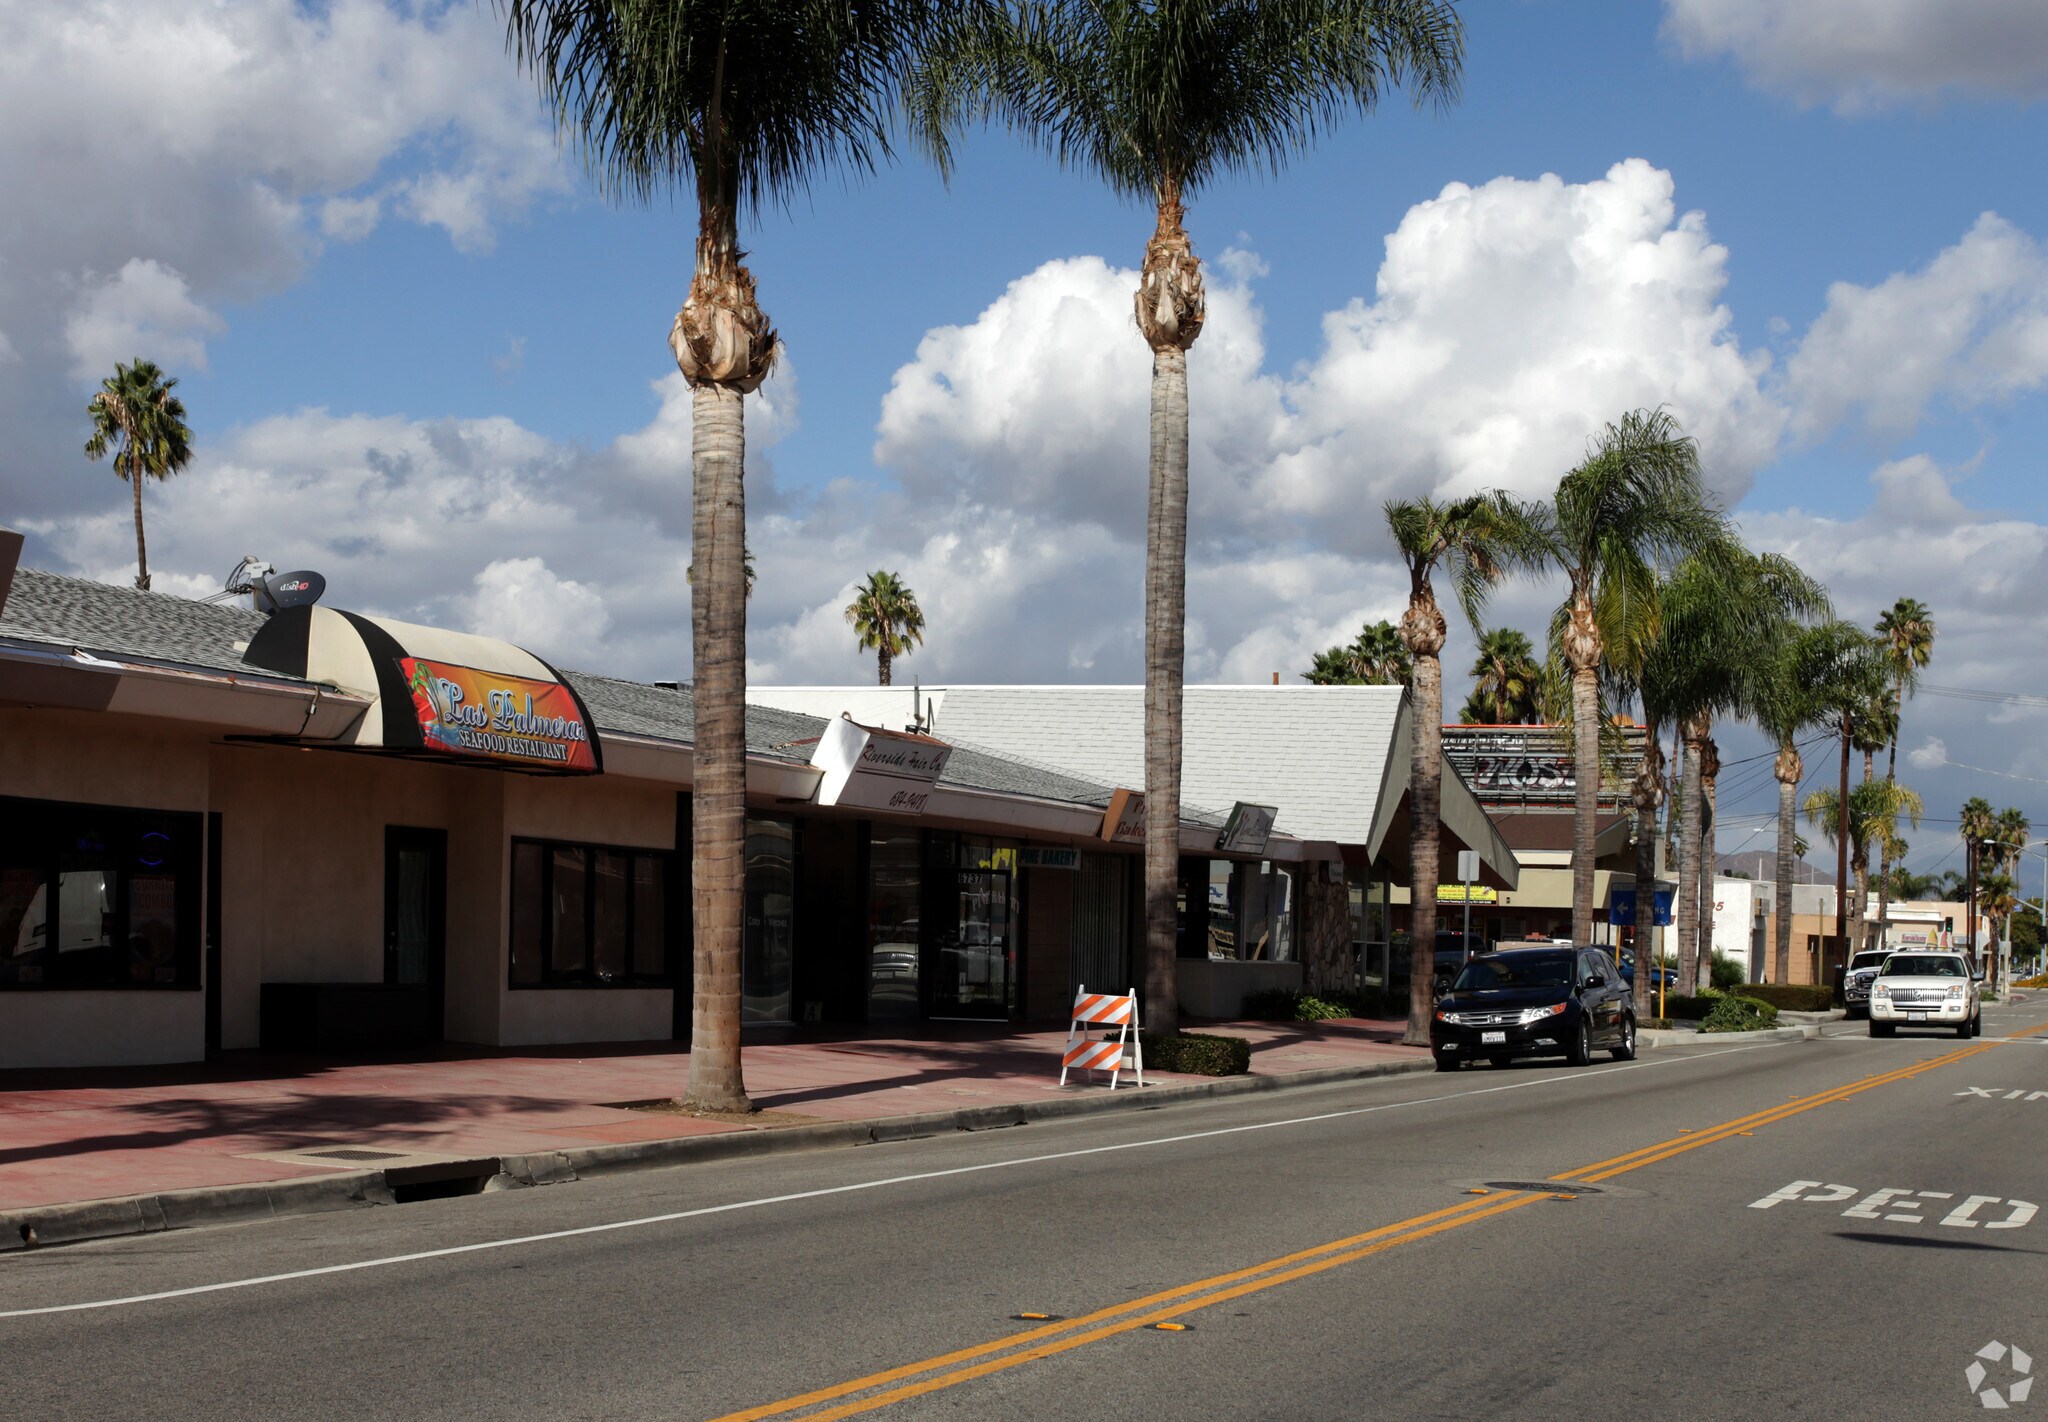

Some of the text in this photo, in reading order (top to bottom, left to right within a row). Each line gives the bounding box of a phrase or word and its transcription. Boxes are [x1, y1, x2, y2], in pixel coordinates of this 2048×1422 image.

[440, 678, 586, 741] Las Palmeras
[459, 730, 568, 760] SEAFOOD RESTAURANT
[861, 743, 906, 767] Riverside
[908, 751, 928, 770] Hair
[1020, 848, 1078, 866] PINE BAKERY
[959, 873, 982, 884] 6737
[1747, 1180, 2040, 1229] PED
